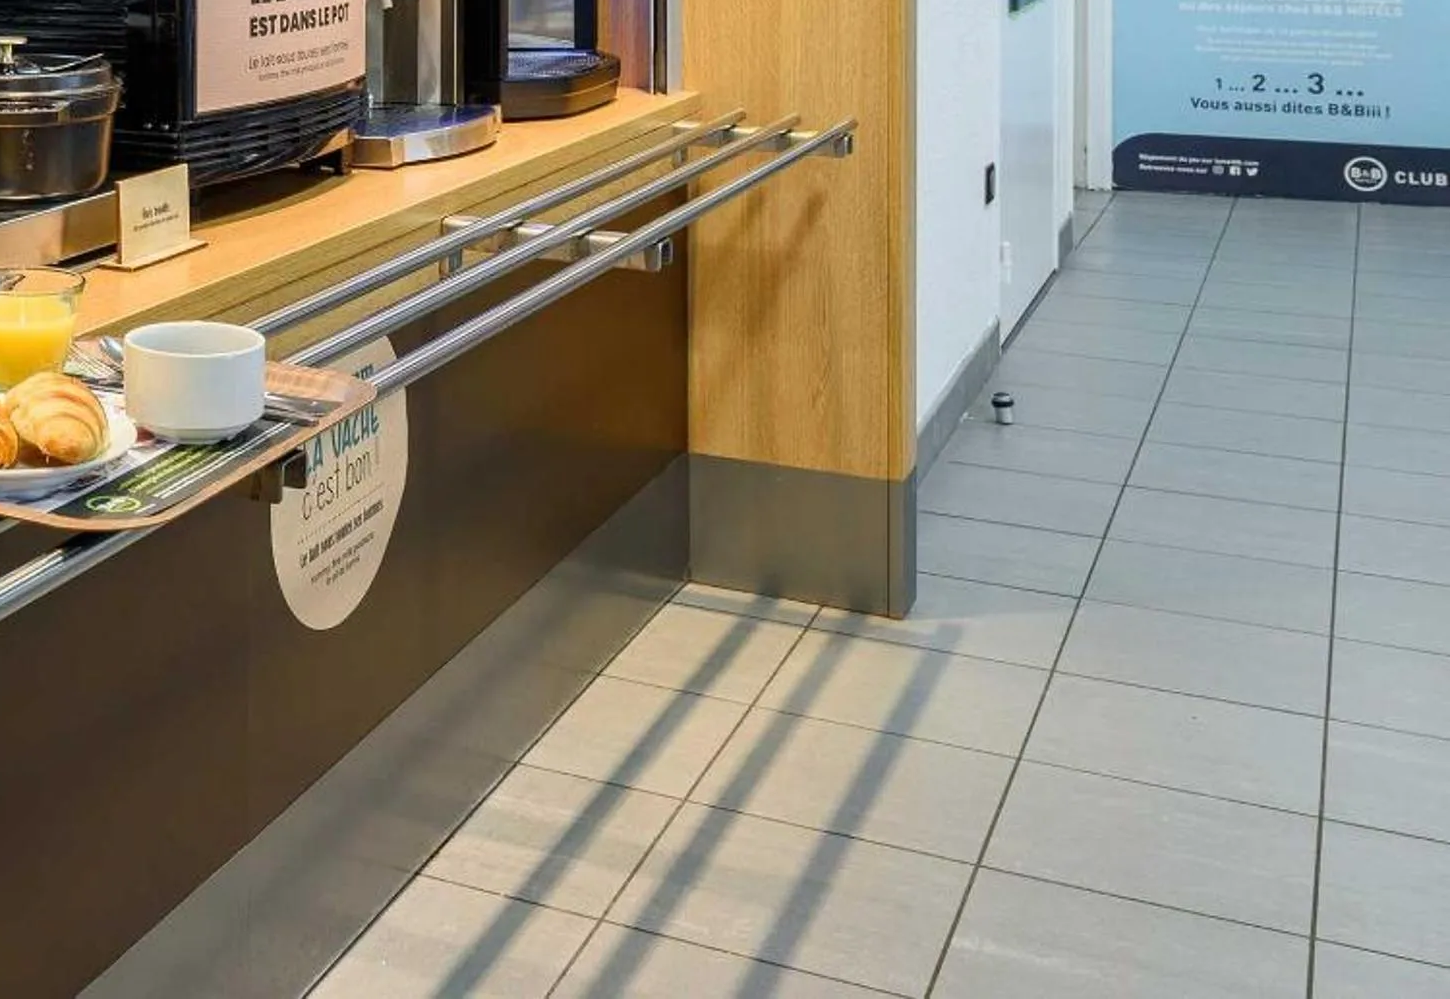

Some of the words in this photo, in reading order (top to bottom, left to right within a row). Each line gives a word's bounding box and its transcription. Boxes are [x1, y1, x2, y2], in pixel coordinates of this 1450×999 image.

[249, 15, 277, 38] EST
[280, 9, 316, 33] DANS
[318, 7, 330, 26] LE
[331, 2, 350, 25] POT
[1215, 77, 1223, 90] 1
[1252, 74, 1266, 92] 2
[1307, 72, 1326, 95] 3
[1190, 96, 1229, 111] Vous
[1234, 98, 1277, 113] aussi
[1281, 100, 1324, 115] dites
[1328, 102, 1382, 118] B&Biii
[1385, 104, 1391, 119] !
[1350, 166, 1382, 180] B&B
[1394, 170, 1449, 187] CLUB
[331, 404, 380, 459] VACHE
[301, 470, 340, 522] c'est
[345, 453, 374, 493] bon
